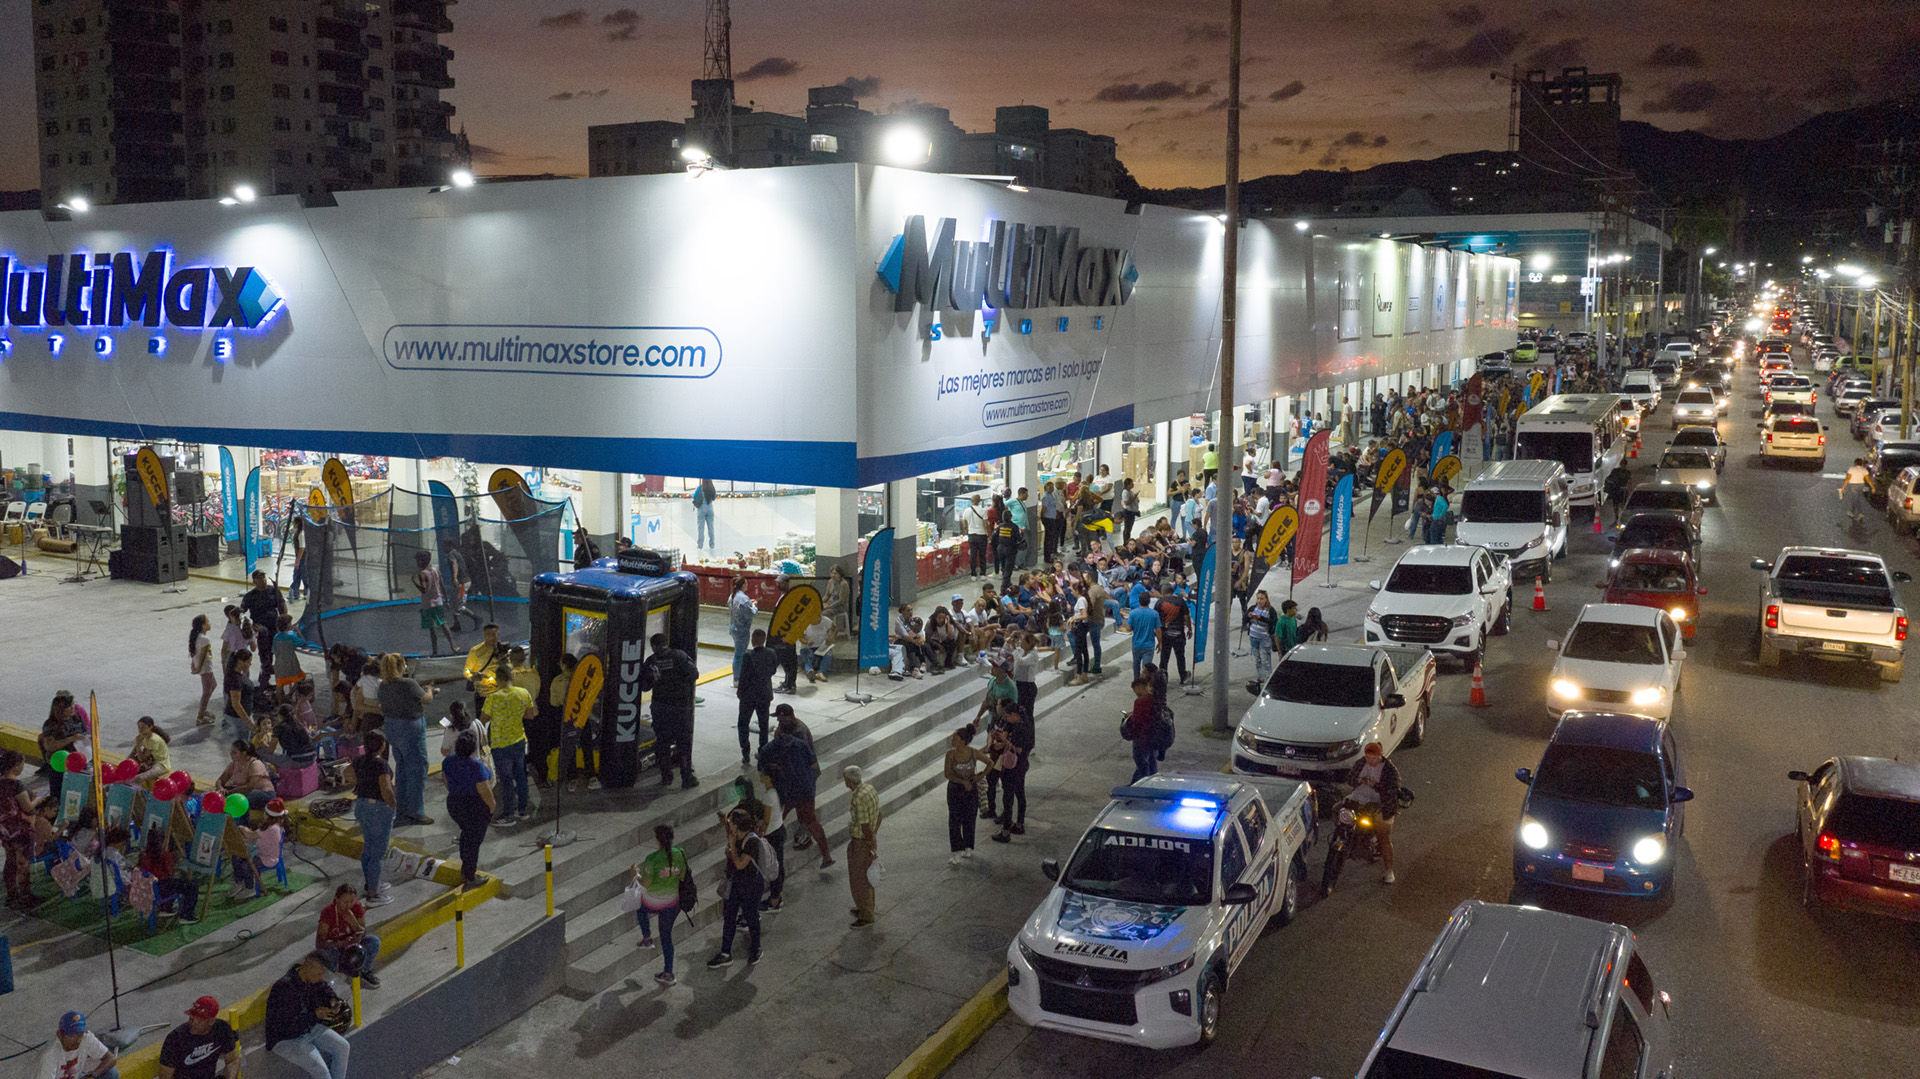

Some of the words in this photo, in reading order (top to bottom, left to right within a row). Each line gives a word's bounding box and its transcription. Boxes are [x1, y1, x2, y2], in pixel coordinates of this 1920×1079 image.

[895, 214, 1121, 312] MultiMax
[394, 334, 707, 368] www.multimaxstore.com
[937, 374, 960, 401] ¡Las
[961, 369, 1005, 396] mejores
[1006, 366, 1044, 386] marcas
[1044, 363, 1056, 381] en
[1058, 361, 1062, 379] 1
[1062, 360, 1080, 379] solo
[986, 398, 1069, 421] www.multimaxstore.com
[225, 469, 233, 515] MultiMax
[250, 496, 258, 543] MultiMax
[1335, 496, 1345, 541] MultiMax
[619, 558, 656, 571] MultiMax
[869, 560, 881, 629] MultiMax
[615, 639, 642, 742] KUCCE
[1054, 942, 1129, 960] POLICIA
[190, 1042, 214, 1058] NIKE
